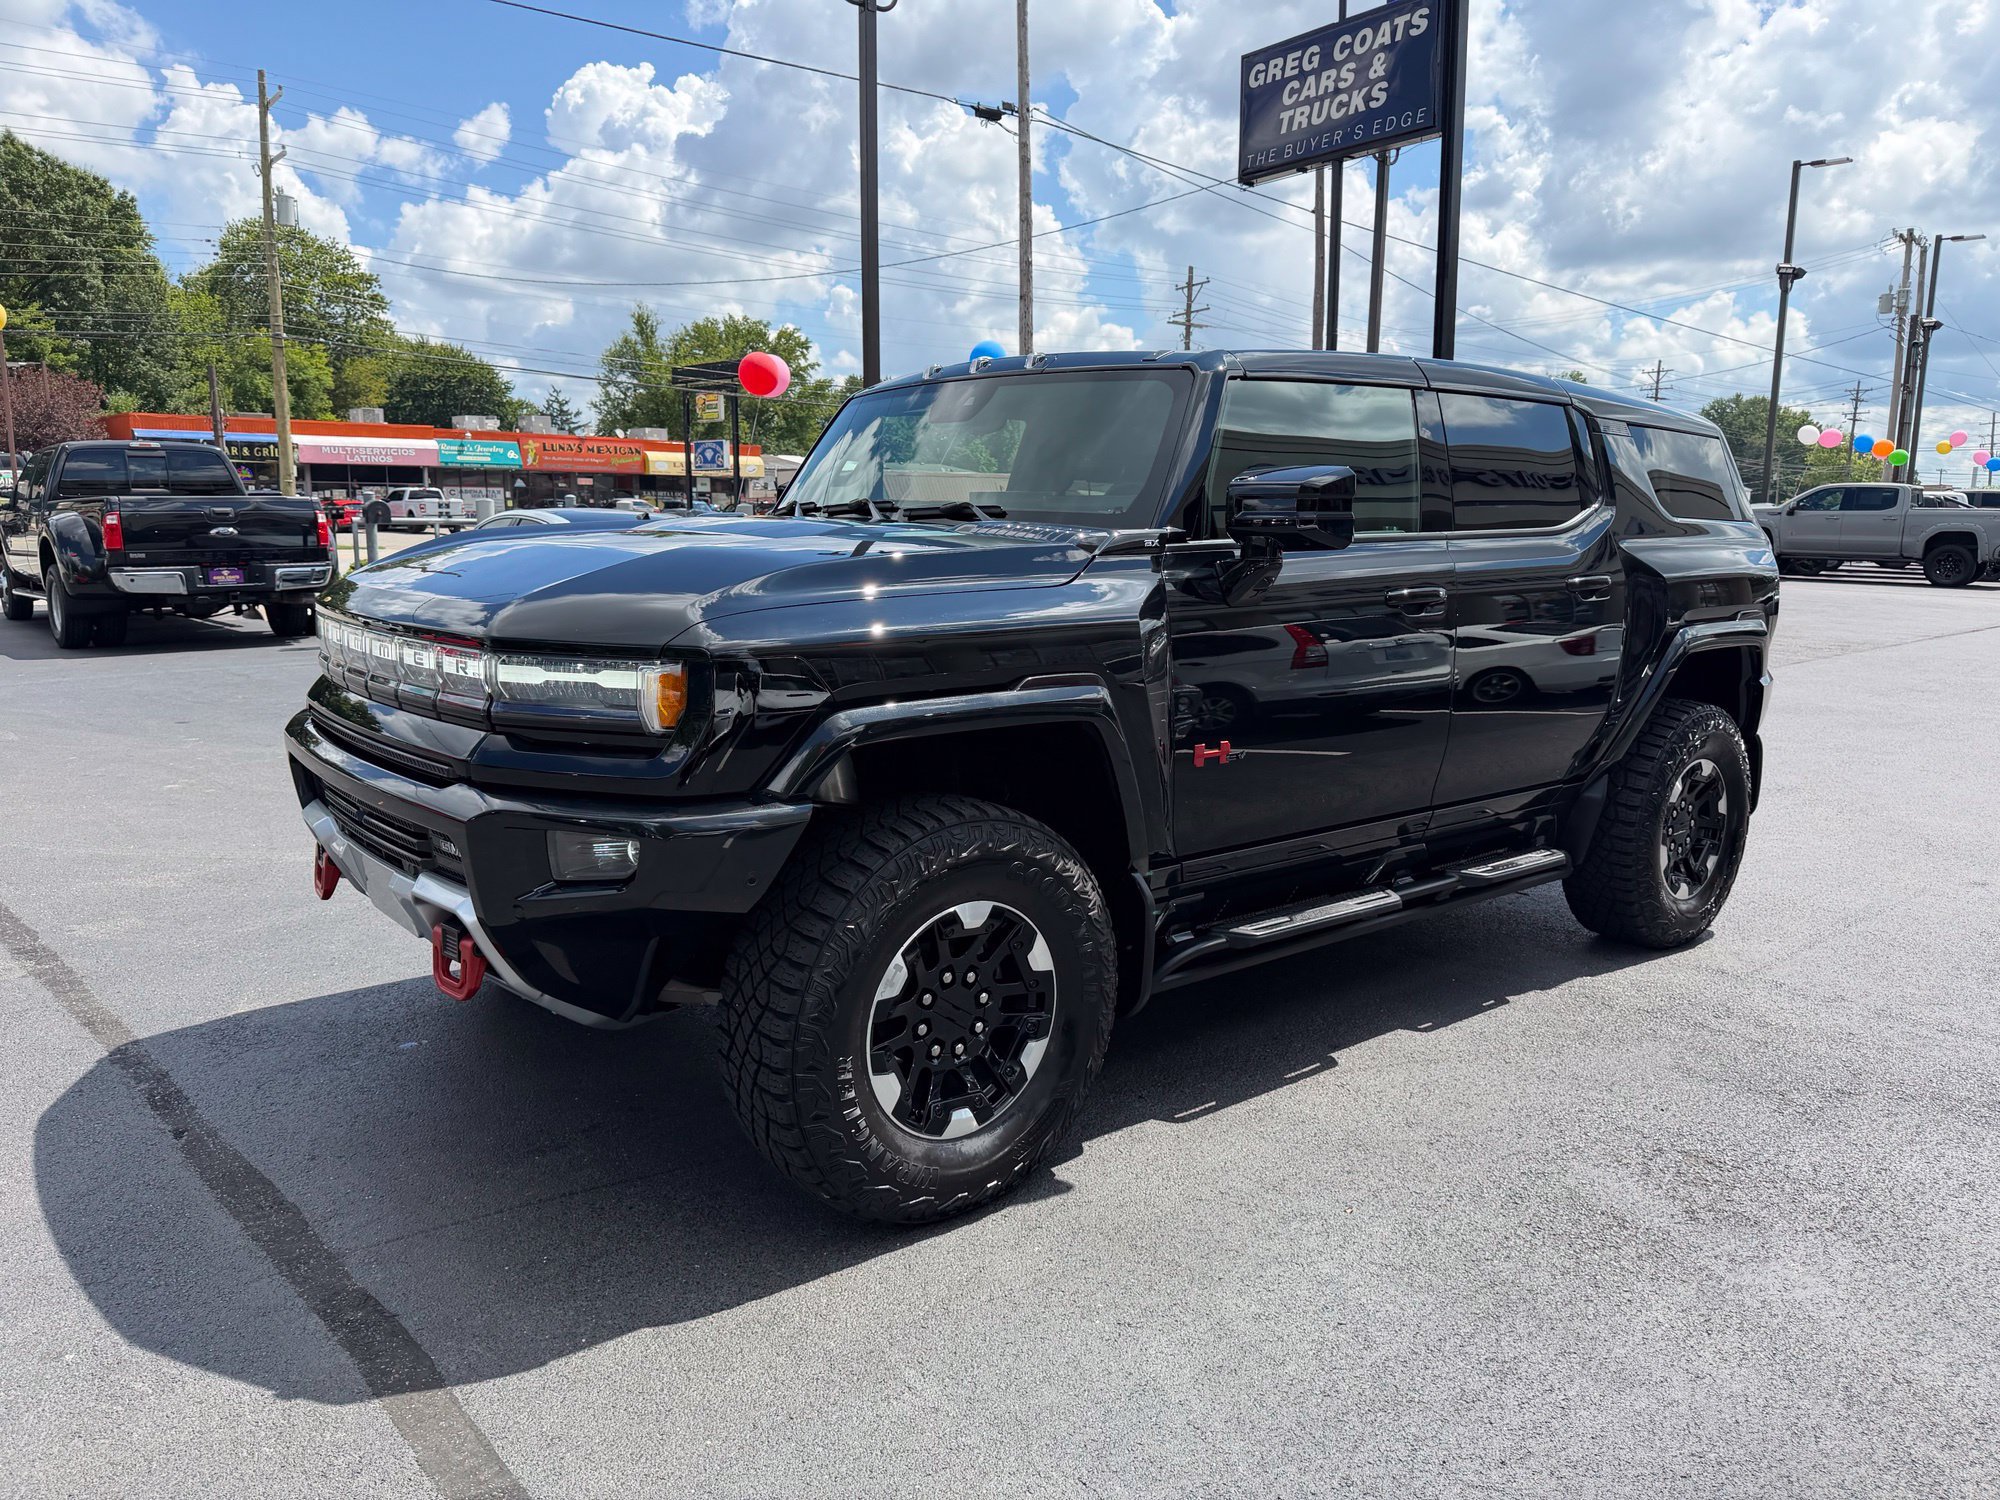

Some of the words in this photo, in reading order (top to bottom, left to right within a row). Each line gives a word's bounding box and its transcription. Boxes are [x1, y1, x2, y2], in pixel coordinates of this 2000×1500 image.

[1249, 45, 1321, 88] GREG
[1333, 7, 1430, 62] COATS
[1282, 62, 1357, 106] CARS
[1368, 52, 1387, 80] &
[1279, 81, 1389, 135] TRUCKS
[1247, 148, 1277, 168] THE
[1284, 124, 1364, 158] BUYER'S
[1372, 107, 1427, 135] EDGE
[224, 446, 238, 456] AR
[242, 446, 250, 457] &
[254, 444, 280, 457] GRIL
[346, 455, 393, 463] LATINOS
[542, 442, 583, 453] LUNA'S
[586, 445, 641, 456] MEXICAN
[837, 1055, 940, 1190] WRANGLER
